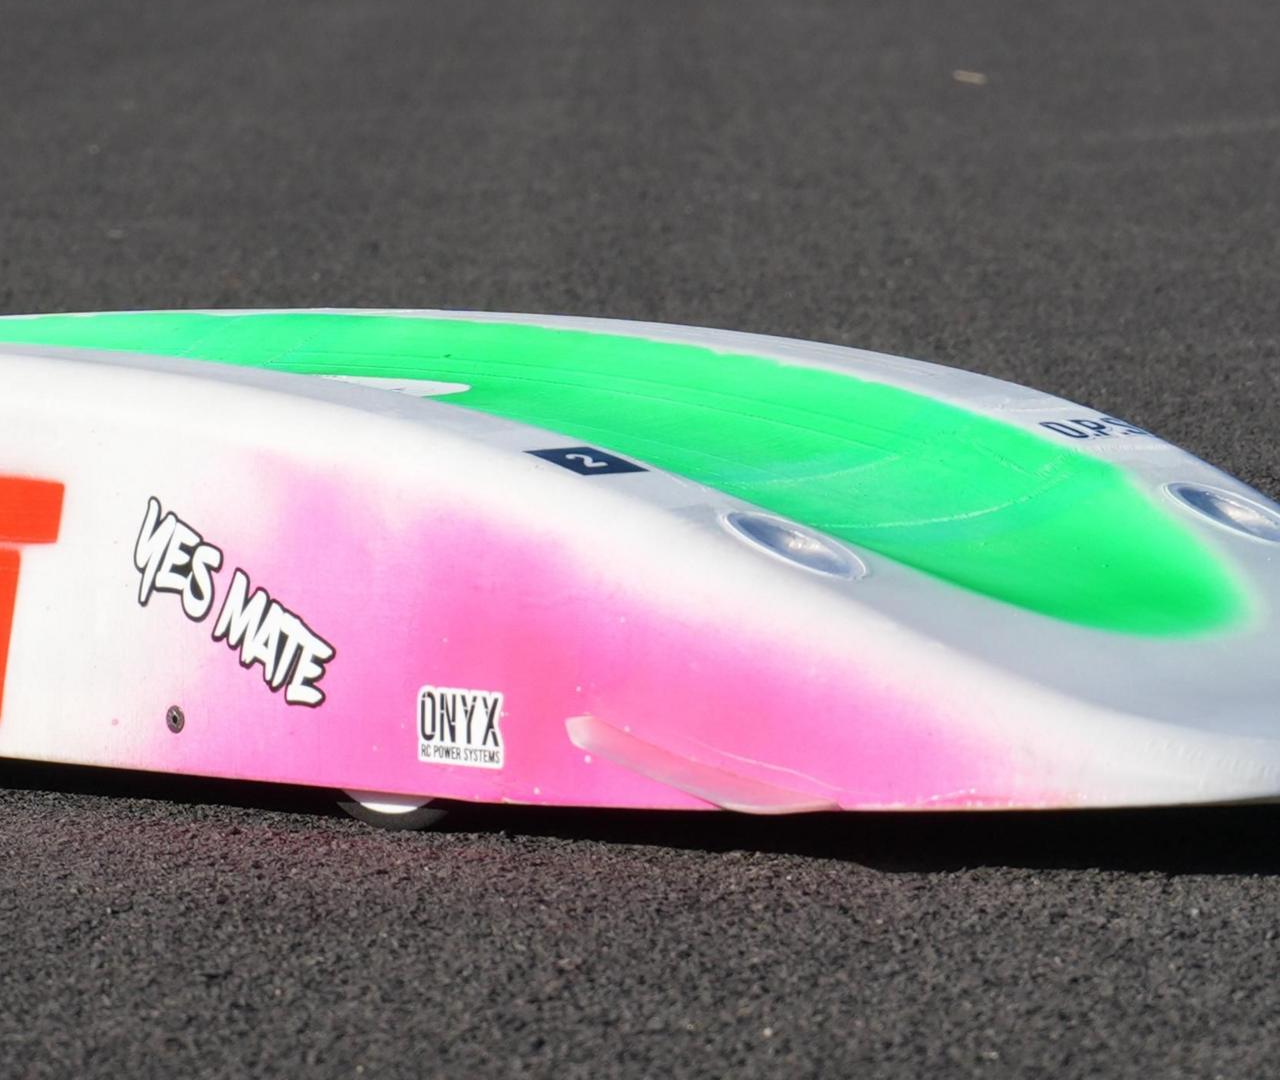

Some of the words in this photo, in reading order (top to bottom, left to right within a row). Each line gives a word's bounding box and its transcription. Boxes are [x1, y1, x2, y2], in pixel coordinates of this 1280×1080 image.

[133, 495, 224, 623] YES
[210, 566, 337, 709] MATE
[420, 690, 500, 747] ONYX
[420, 744, 432, 758] RC
[433, 745, 462, 761] POWER
[463, 747, 501, 764] SYSTEMS
